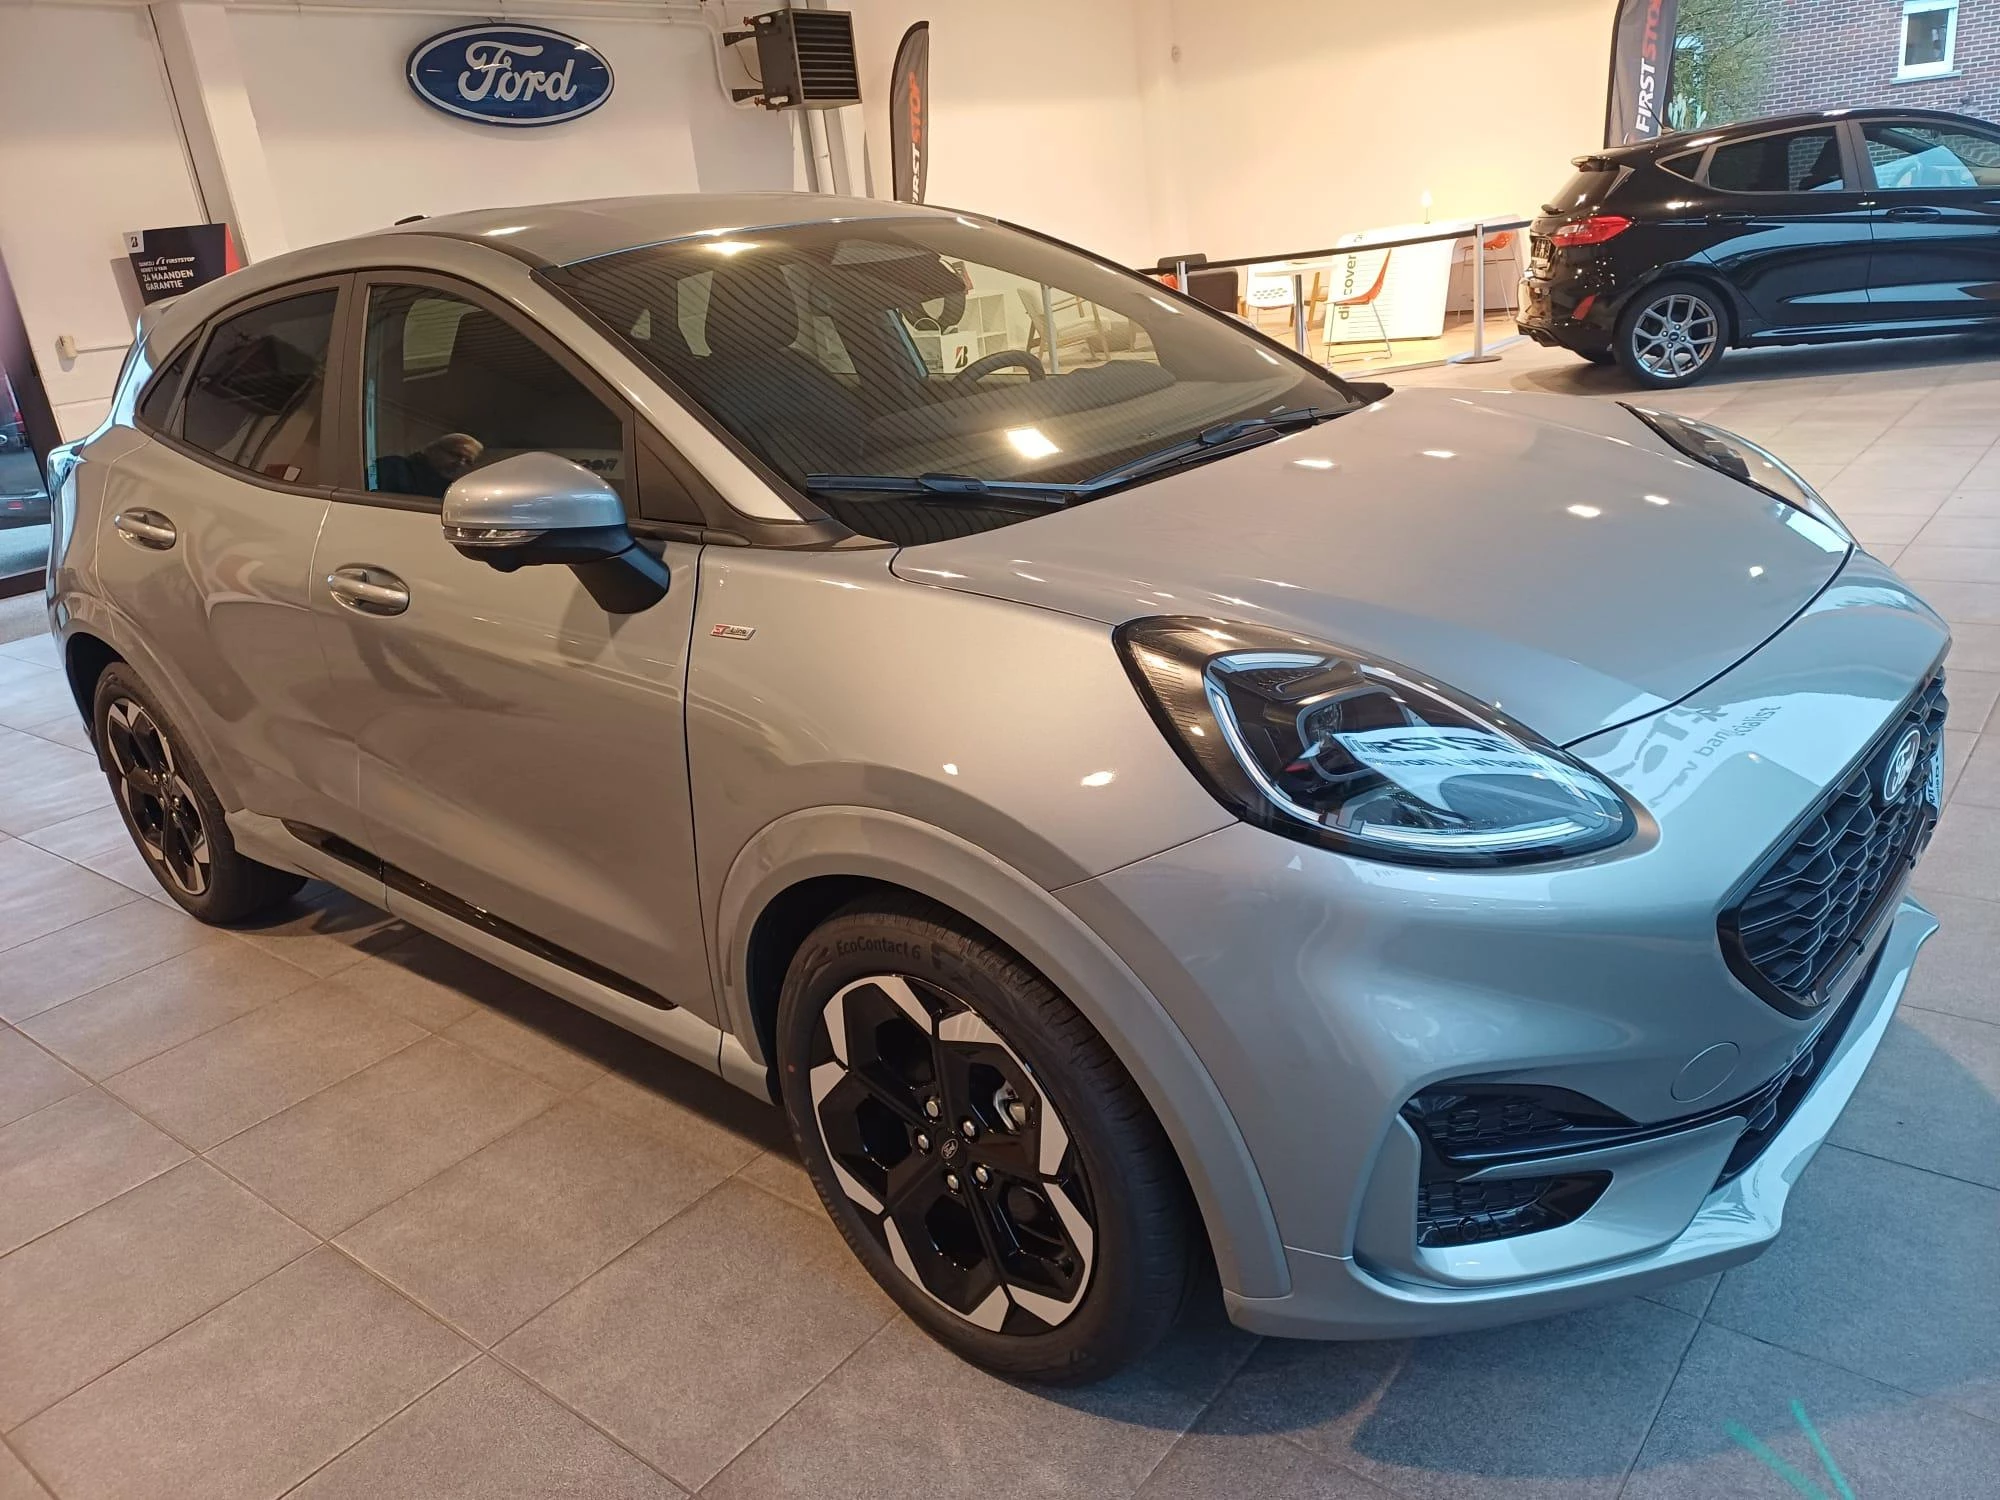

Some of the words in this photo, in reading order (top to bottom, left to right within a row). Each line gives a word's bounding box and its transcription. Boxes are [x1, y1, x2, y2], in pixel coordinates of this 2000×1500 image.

[458, 41, 577, 101] Ford
[151, 270, 194, 280] MAANDEN
[145, 280, 184, 290] GARANTIE
[836, 936, 908, 958] EcoContact
[911, 944, 921, 960] 6
